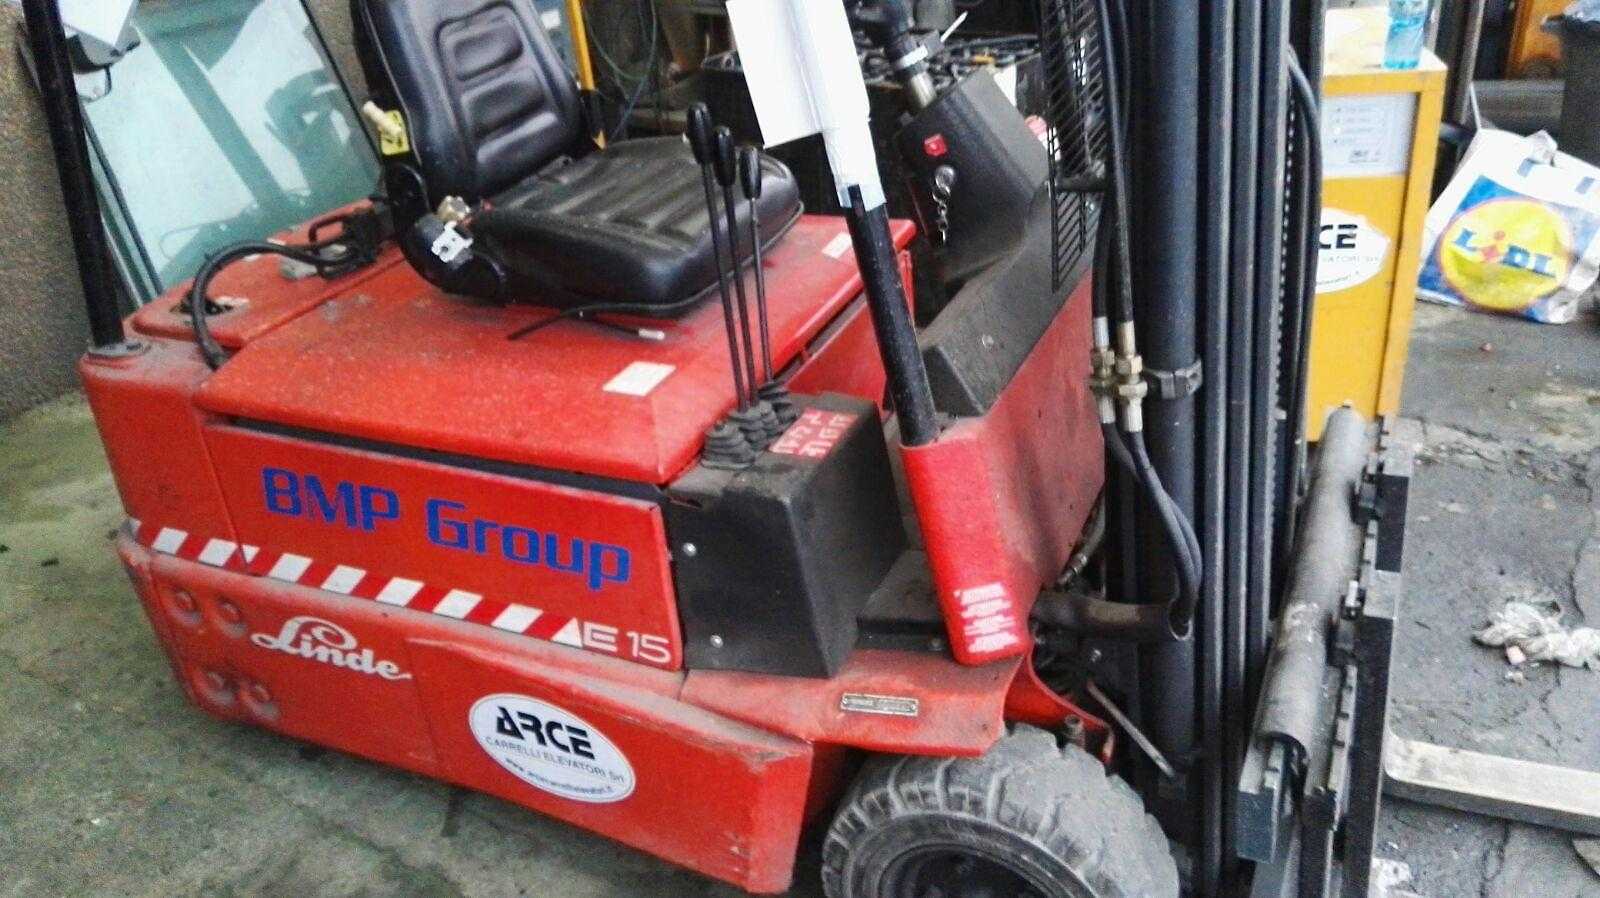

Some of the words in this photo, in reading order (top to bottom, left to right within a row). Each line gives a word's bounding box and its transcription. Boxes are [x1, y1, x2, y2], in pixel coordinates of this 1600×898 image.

[262, 467, 400, 531] BMP
[426, 498, 632, 591] Group
[251, 615, 413, 680] Linde
[626, 631, 672, 664] 15
[485, 736, 541, 759] CARRELLI
[543, 750, 606, 778] ELEVATORI
[496, 706, 596, 760] ARCE
